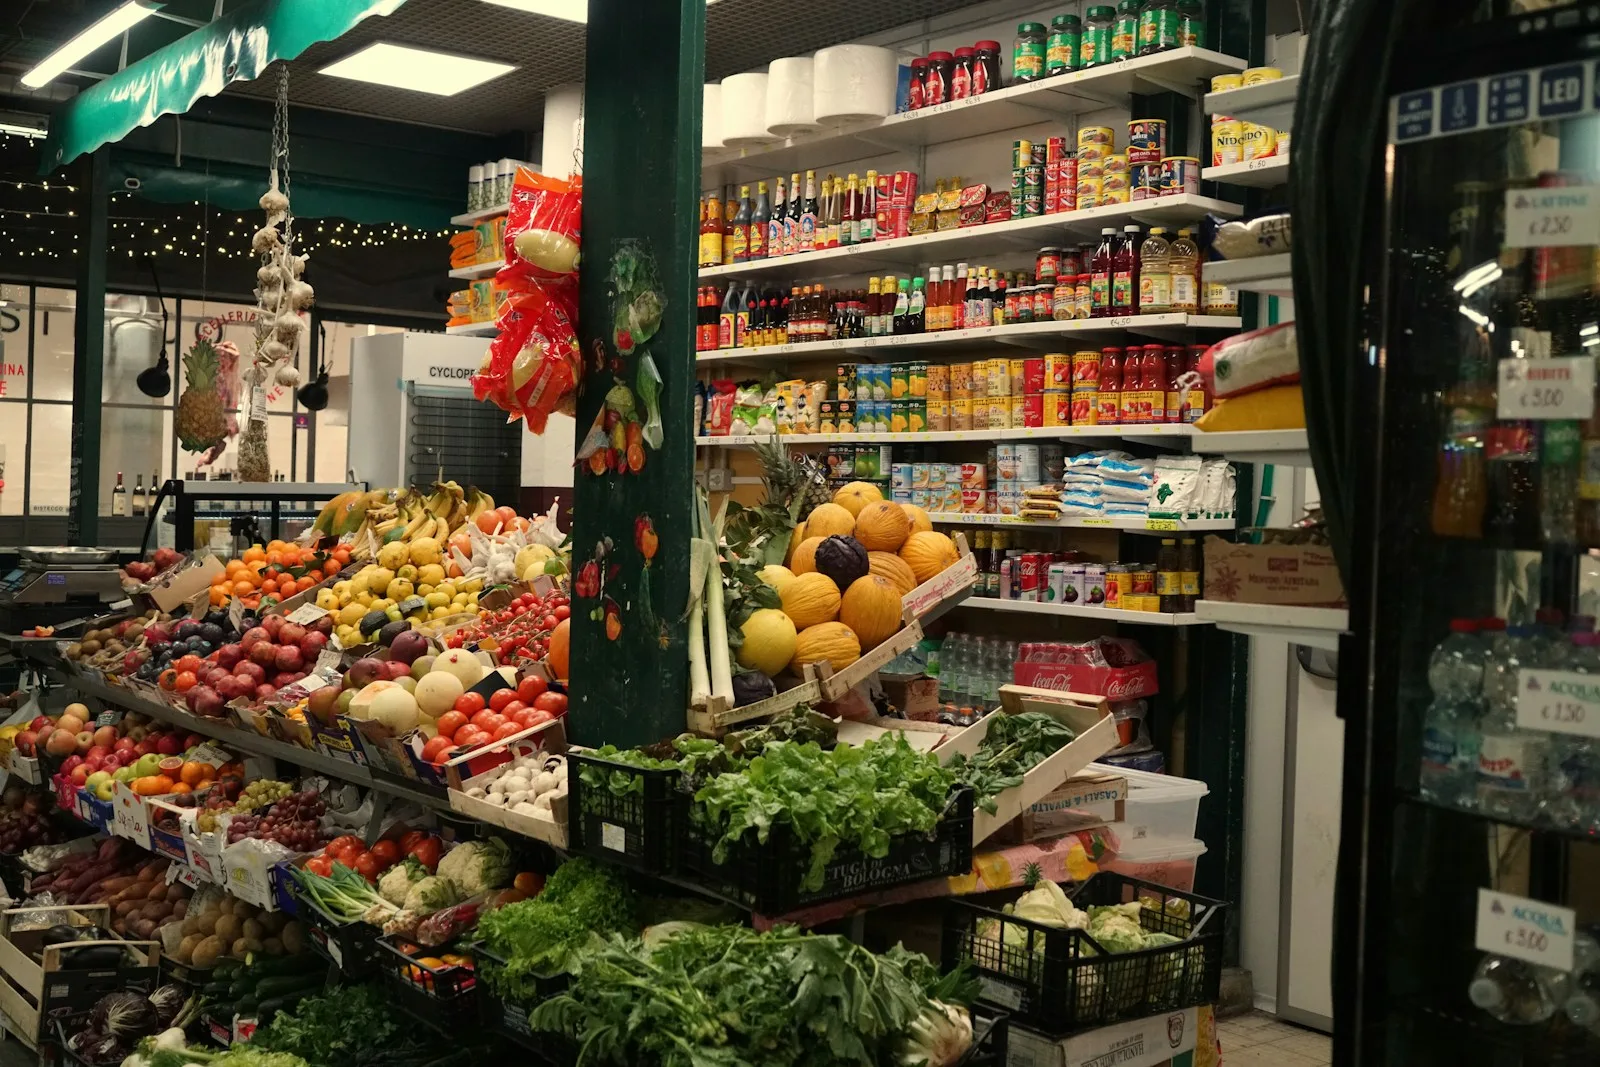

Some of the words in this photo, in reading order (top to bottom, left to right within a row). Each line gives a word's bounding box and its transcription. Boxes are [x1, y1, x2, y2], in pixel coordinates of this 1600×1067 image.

[1541, 77, 1581, 106] LED
[1031, 799, 1072, 813] RIVALTA
[1084, 790, 1118, 805] CASALI
[843, 863, 911, 889] BOLOGNA
